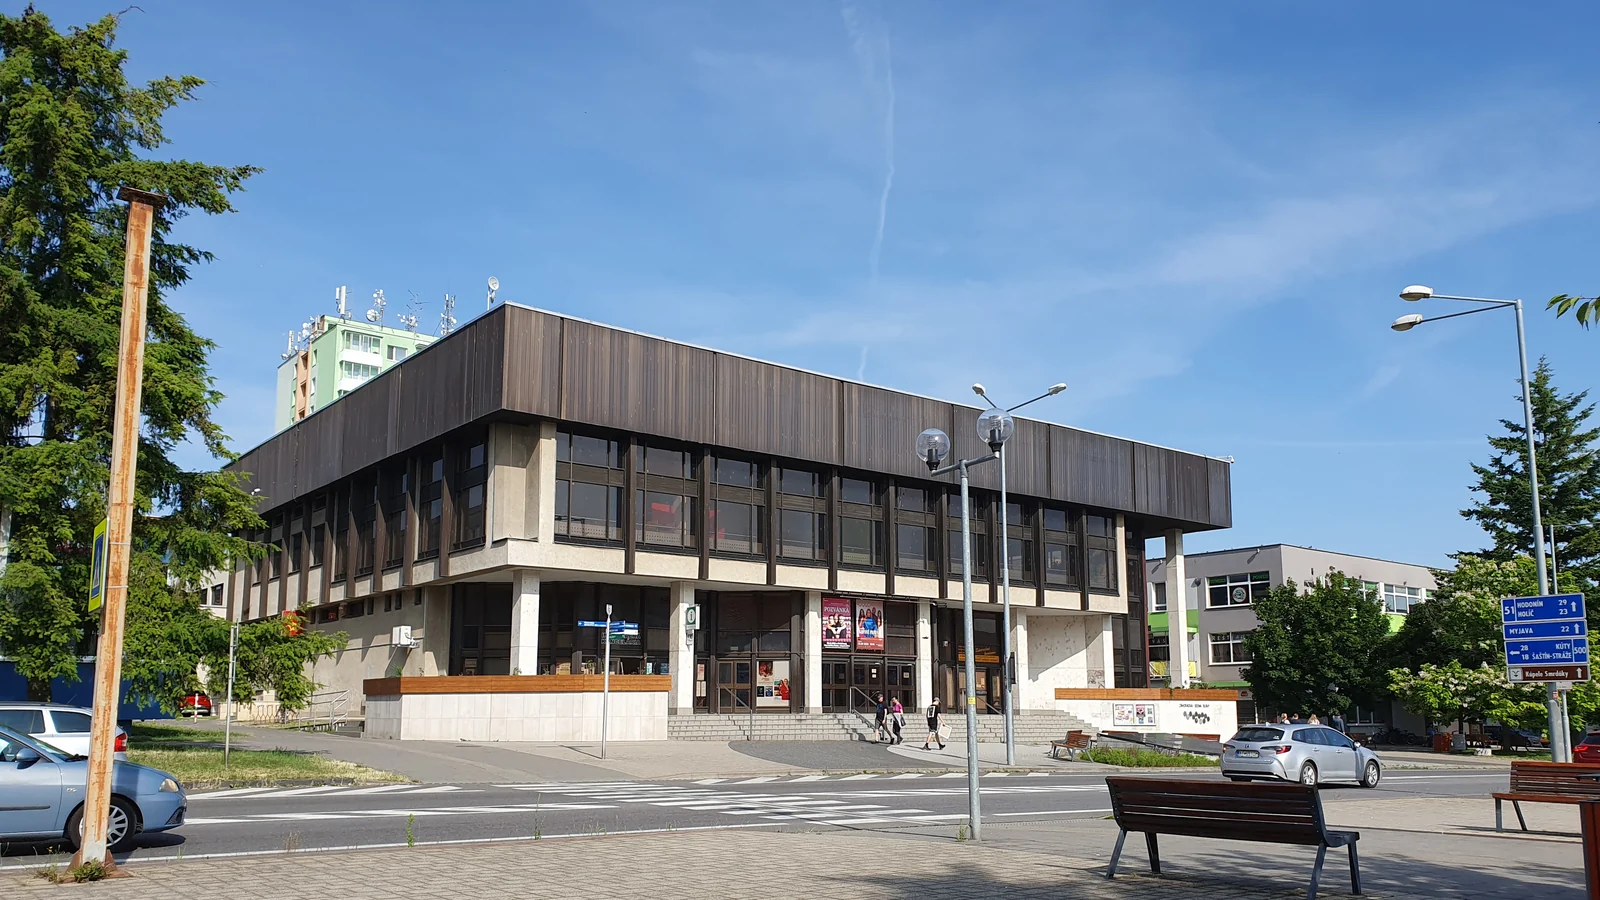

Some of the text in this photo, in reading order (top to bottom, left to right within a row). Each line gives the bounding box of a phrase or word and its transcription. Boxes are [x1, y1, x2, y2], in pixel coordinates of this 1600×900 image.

[1517, 600, 1543, 608] HODONÍN
[824, 605, 849, 613] POZVÁNKA
[1504, 606, 1515, 614] 51
[1518, 609, 1534, 617] HOLÍČ
